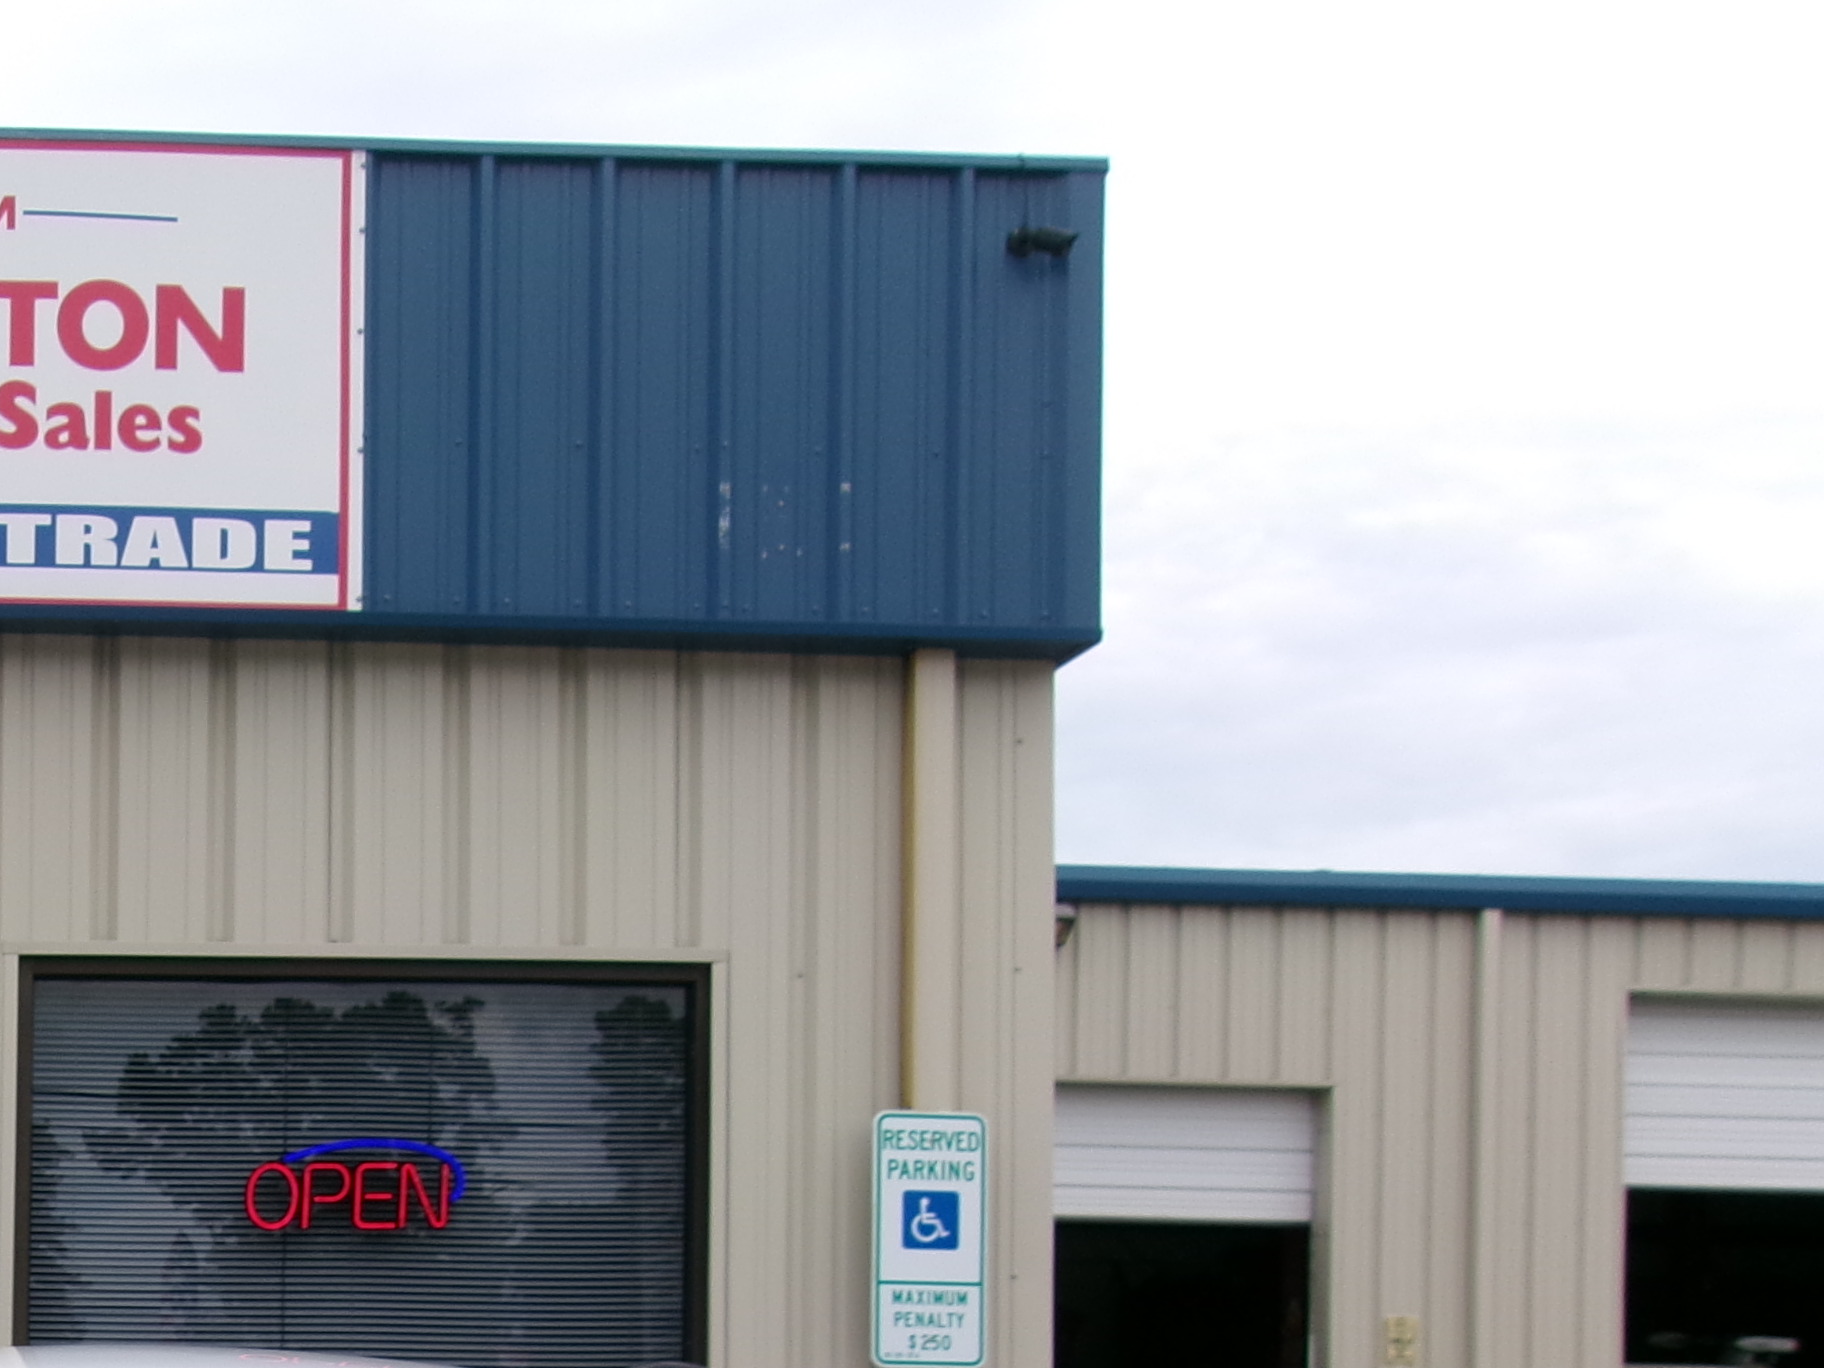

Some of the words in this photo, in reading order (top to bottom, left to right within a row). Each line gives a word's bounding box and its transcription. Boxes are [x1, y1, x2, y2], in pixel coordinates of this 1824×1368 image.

[882, 1129, 981, 1152] RESERVED
[887, 1159, 975, 1182] PARKING
[243, 1160, 451, 1232] OPEN
[892, 1289, 969, 1305] MAXIMUM
[893, 1310, 965, 1329] PENALTY
